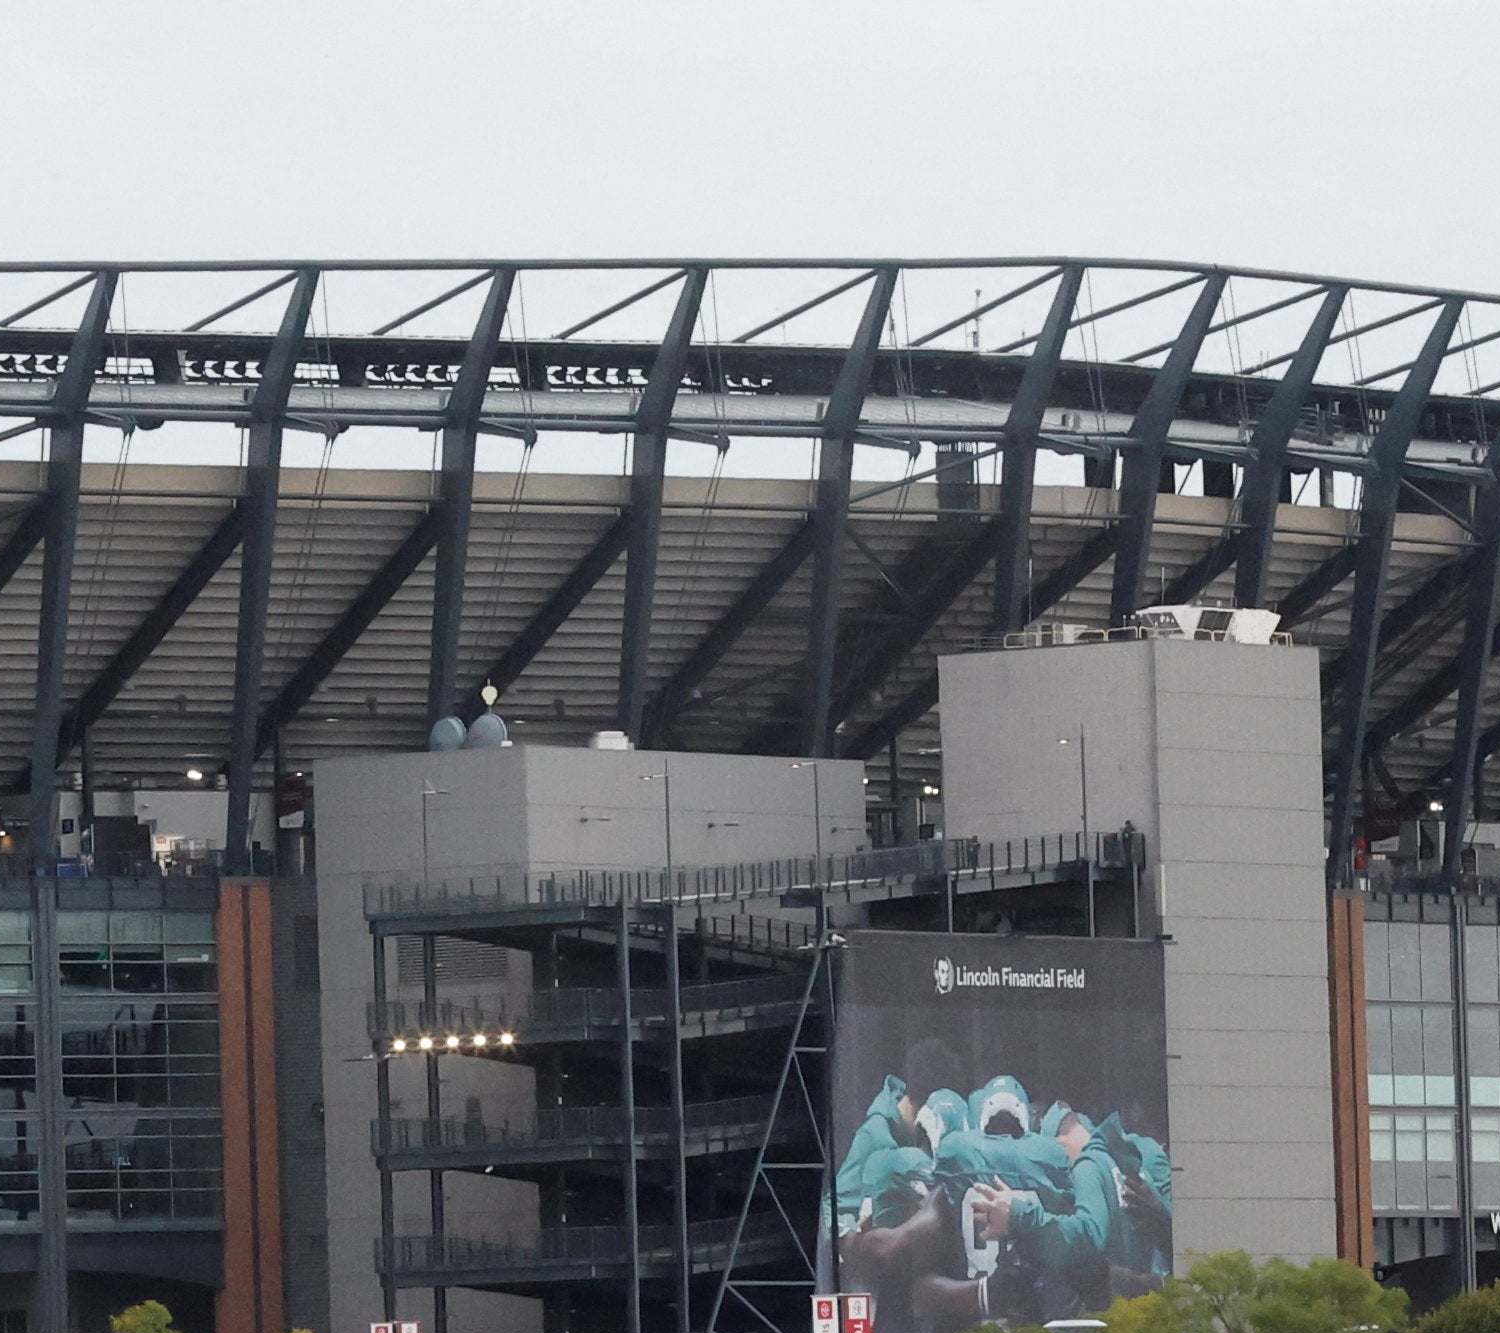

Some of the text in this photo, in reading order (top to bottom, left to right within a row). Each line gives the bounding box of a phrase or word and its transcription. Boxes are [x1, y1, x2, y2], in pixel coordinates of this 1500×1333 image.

[956, 966, 1085, 989] Lincoln Financial Field
